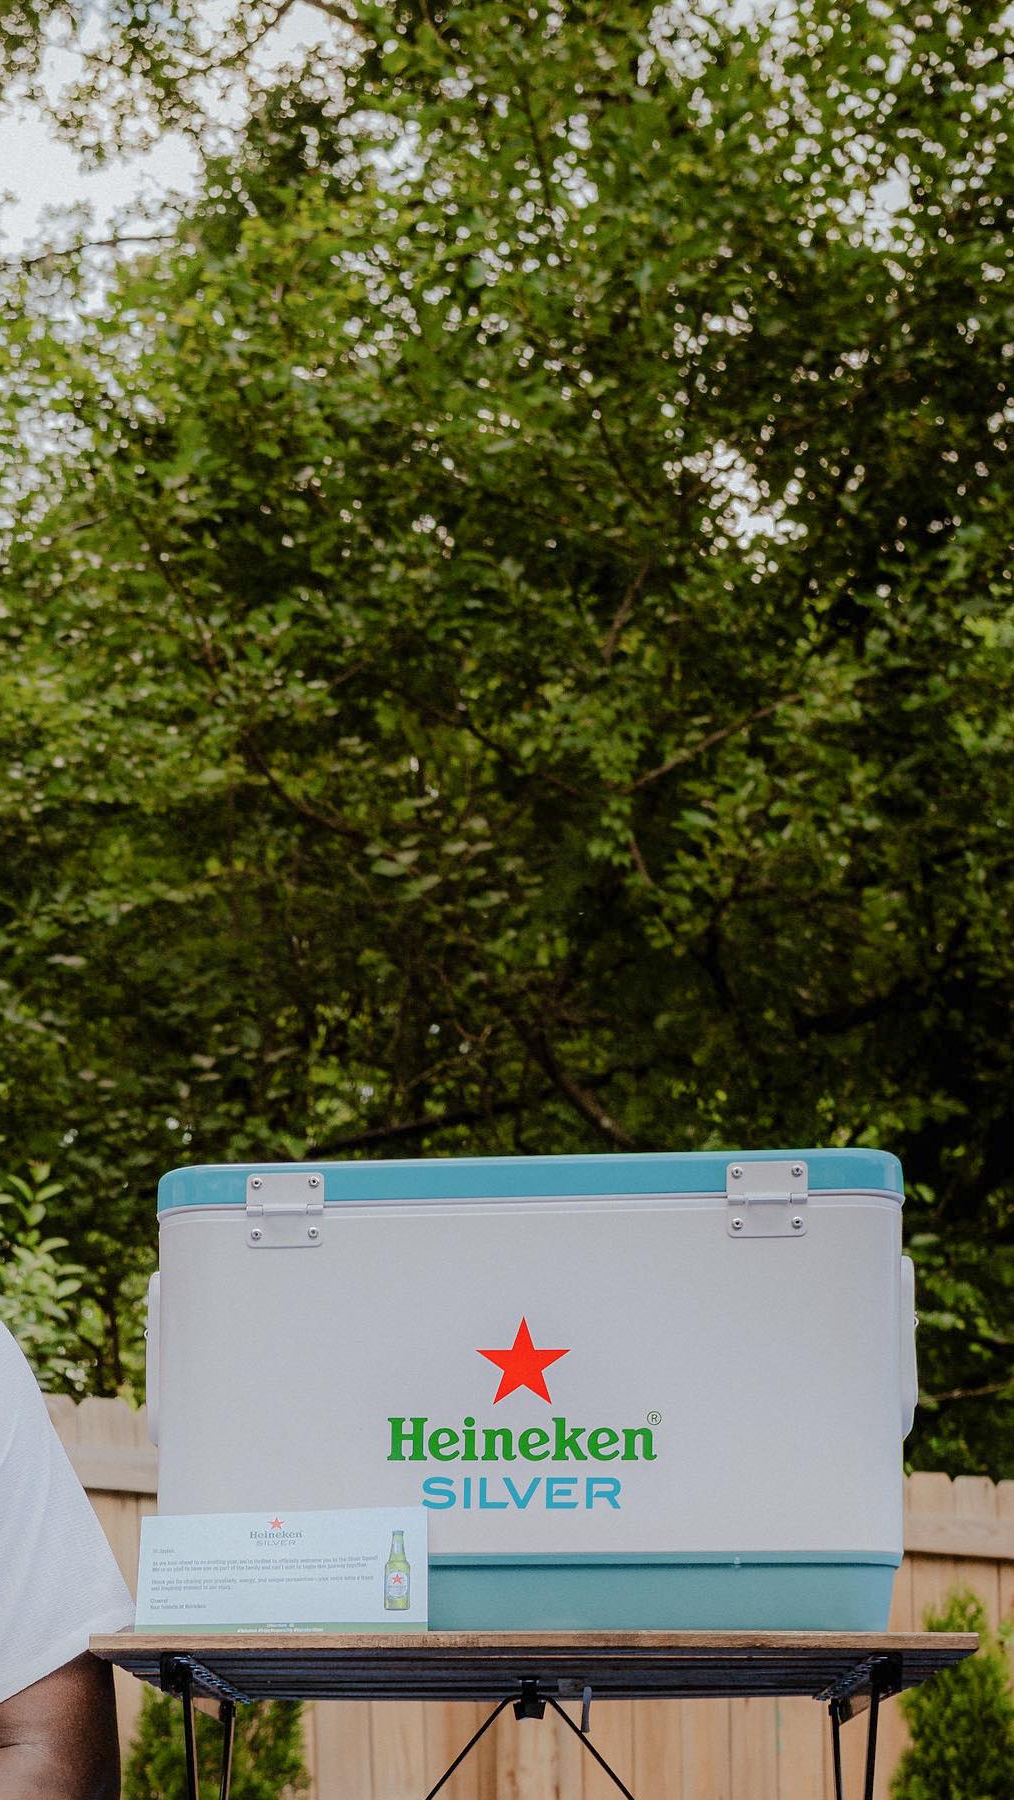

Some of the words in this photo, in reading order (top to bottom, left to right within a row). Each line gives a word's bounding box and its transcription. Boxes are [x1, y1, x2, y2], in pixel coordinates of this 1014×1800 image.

[387, 1416, 658, 1462] Heineken
[421, 1476, 622, 1510] SILVER
[249, 1530, 303, 1539] Heineken
[256, 1539, 297, 1547] SILVER
